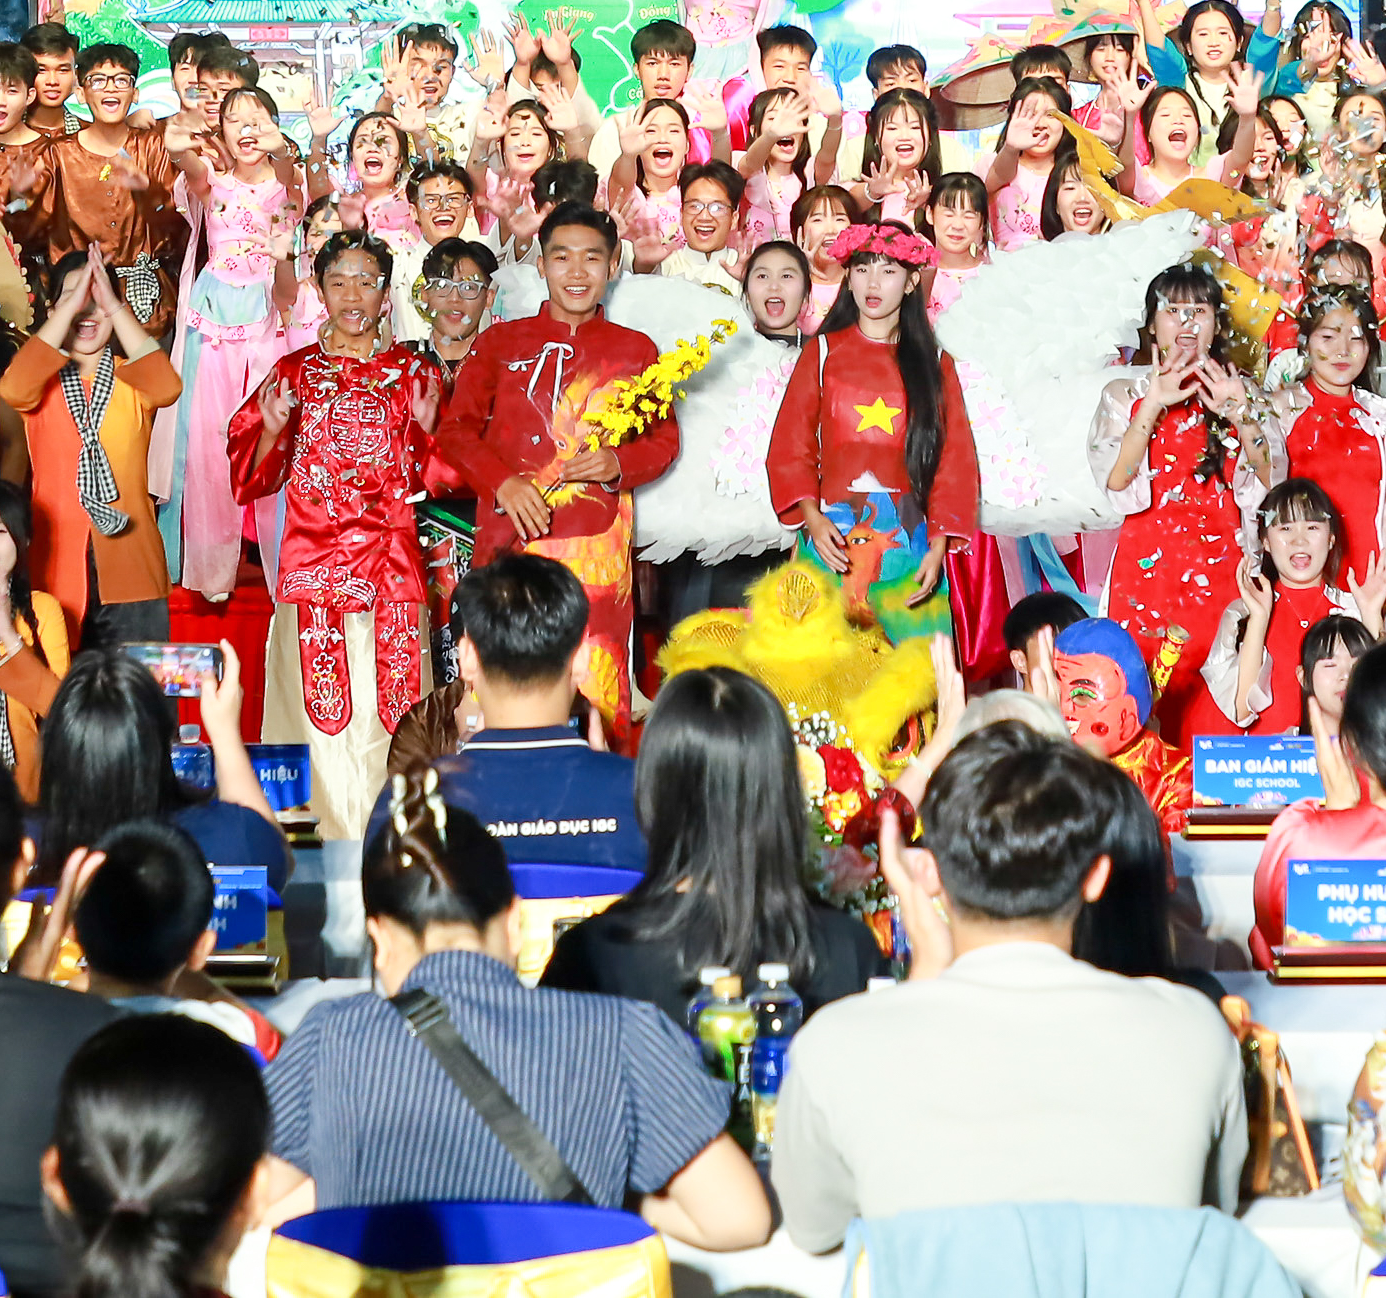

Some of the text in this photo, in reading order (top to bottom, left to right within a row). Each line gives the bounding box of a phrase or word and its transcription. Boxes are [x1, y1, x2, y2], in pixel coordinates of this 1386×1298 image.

[260, 765, 298, 784] HIỆU
[1205, 756, 1318, 776] BAN GIÁM HIỆ
[1234, 777, 1302, 789] IGC SCHOOL
[486, 817, 617, 837] OÀN GIÁO DỤC IGC
[1317, 883, 1360, 904] PHỤ
[1328, 906, 1371, 926] HỌC
